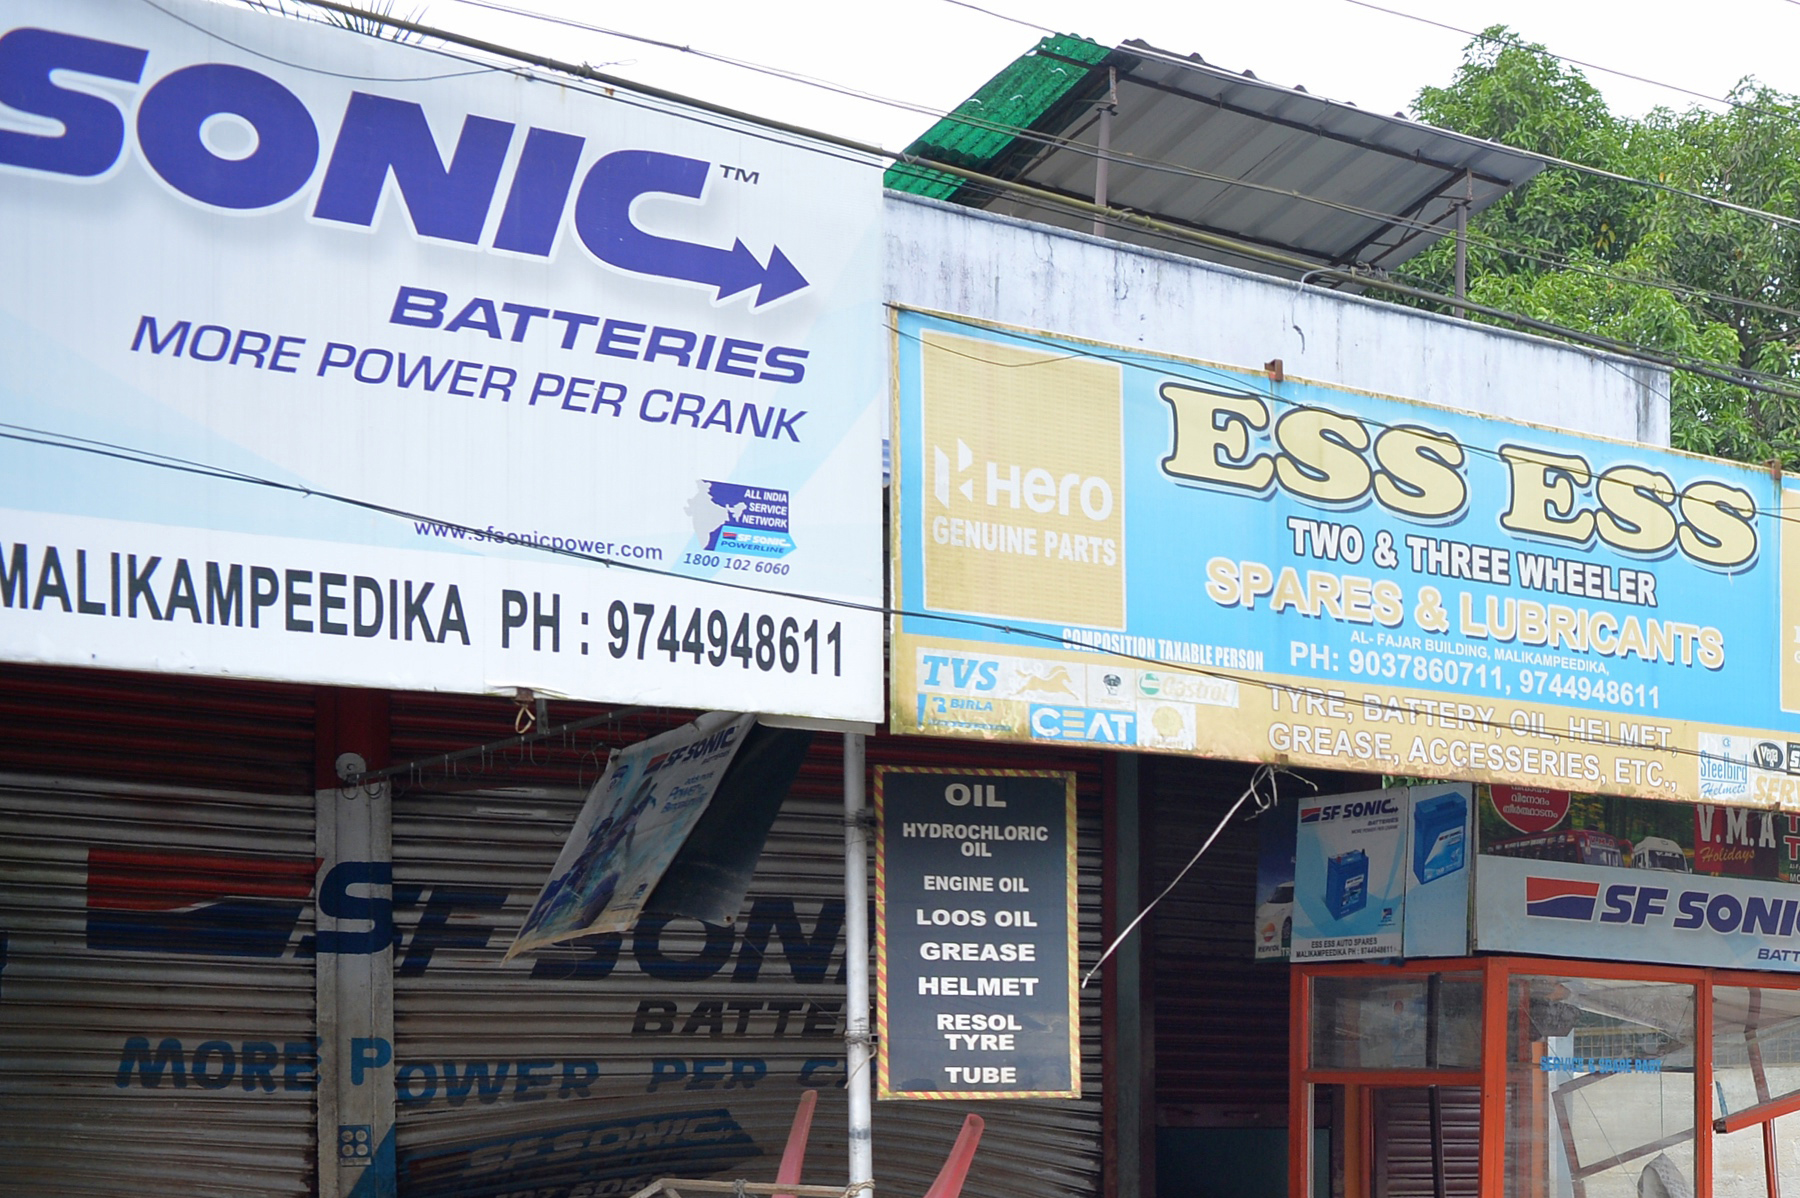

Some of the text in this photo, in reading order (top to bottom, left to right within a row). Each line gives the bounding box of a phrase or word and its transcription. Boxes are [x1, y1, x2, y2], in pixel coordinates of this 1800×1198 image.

[0, 27, 810, 308] SONIC
[390, 285, 811, 385] BATTERIES
[131, 315, 808, 444] MORE POWER PER CRANK
[1160, 382, 1758, 567] ESS ESS
[744, 489, 787, 503] ALL INDIA
[986, 461, 1113, 521] Hero
[749, 502, 787, 516] SERVICE
[742, 514, 787, 529] NETWORK
[414, 518, 664, 563] www.sfsonicpower.com
[721, 540, 785, 554] POWERLINE
[932, 516, 1116, 566] GENUINE PARTS
[683, 552, 790, 576] 1800 102 6060
[1288, 518, 1657, 606] TWO & THREE WHEELER
[1206, 558, 1725, 669] SPARES & LUBRICANTS
[501, 589, 561, 653] PH
[607, 603, 843, 678] 9744948611
[1062, 628, 1263, 672] COMPOSITION TAXABLE PERSON
[1377, 633, 1421, 651] FAJAR
[1425, 639, 1491, 660] BUILDING,
[1494, 648, 1610, 676] MALIKAMPEEDIKA,
[922, 654, 999, 691] TVS
[1290, 641, 1660, 710] PH: 9037860711, 9744948611
[1163, 675, 1229, 701] Castrol
[950, 698, 993, 712] BIRLA
[1031, 706, 1134, 742] CEAT
[1266, 683, 1679, 758] TYRE, BATTERY, OIL, HELMET,
[662, 726, 738, 768] SF SONIC
[1268, 722, 1677, 793] GREASE, ACCESSERIES, ETC.,
[1760, 745, 1778, 767] Vega
[1700, 750, 1747, 782] Steelbird
[945, 783, 1007, 808] OIL
[1702, 783, 1746, 797] Helmets
[1321, 799, 1398, 821] SF SONIC
[1367, 817, 1399, 826] BATTERIES
[903, 822, 1048, 842] HYDROCHLORIC
[961, 842, 992, 857] OIL
[1700, 846, 1755, 869] Holidays
[924, 875, 1029, 893] ENGINE OIL
[1600, 883, 1667, 925] SF
[916, 909, 1038, 927] LOOS OIL
[920, 942, 1036, 962] GREASE
[1296, 948, 1346, 958] MALIKAMPEEDIKA
[1311, 937, 1378, 949] ESS ESS AUTO SPARES
[918, 976, 1039, 996] HELMET
[936, 1013, 1023, 1031] RESOL
[944, 1034, 1015, 1051] TYRE
[115, 1037, 321, 1092] MORE
[350, 1037, 600, 1106] POWER
[647, 1057, 768, 1093] PER
[944, 1067, 1017, 1084] TUBE
[1540, 1056, 1584, 1073] SERVICE
[1598, 1058, 1631, 1074] SPARE
